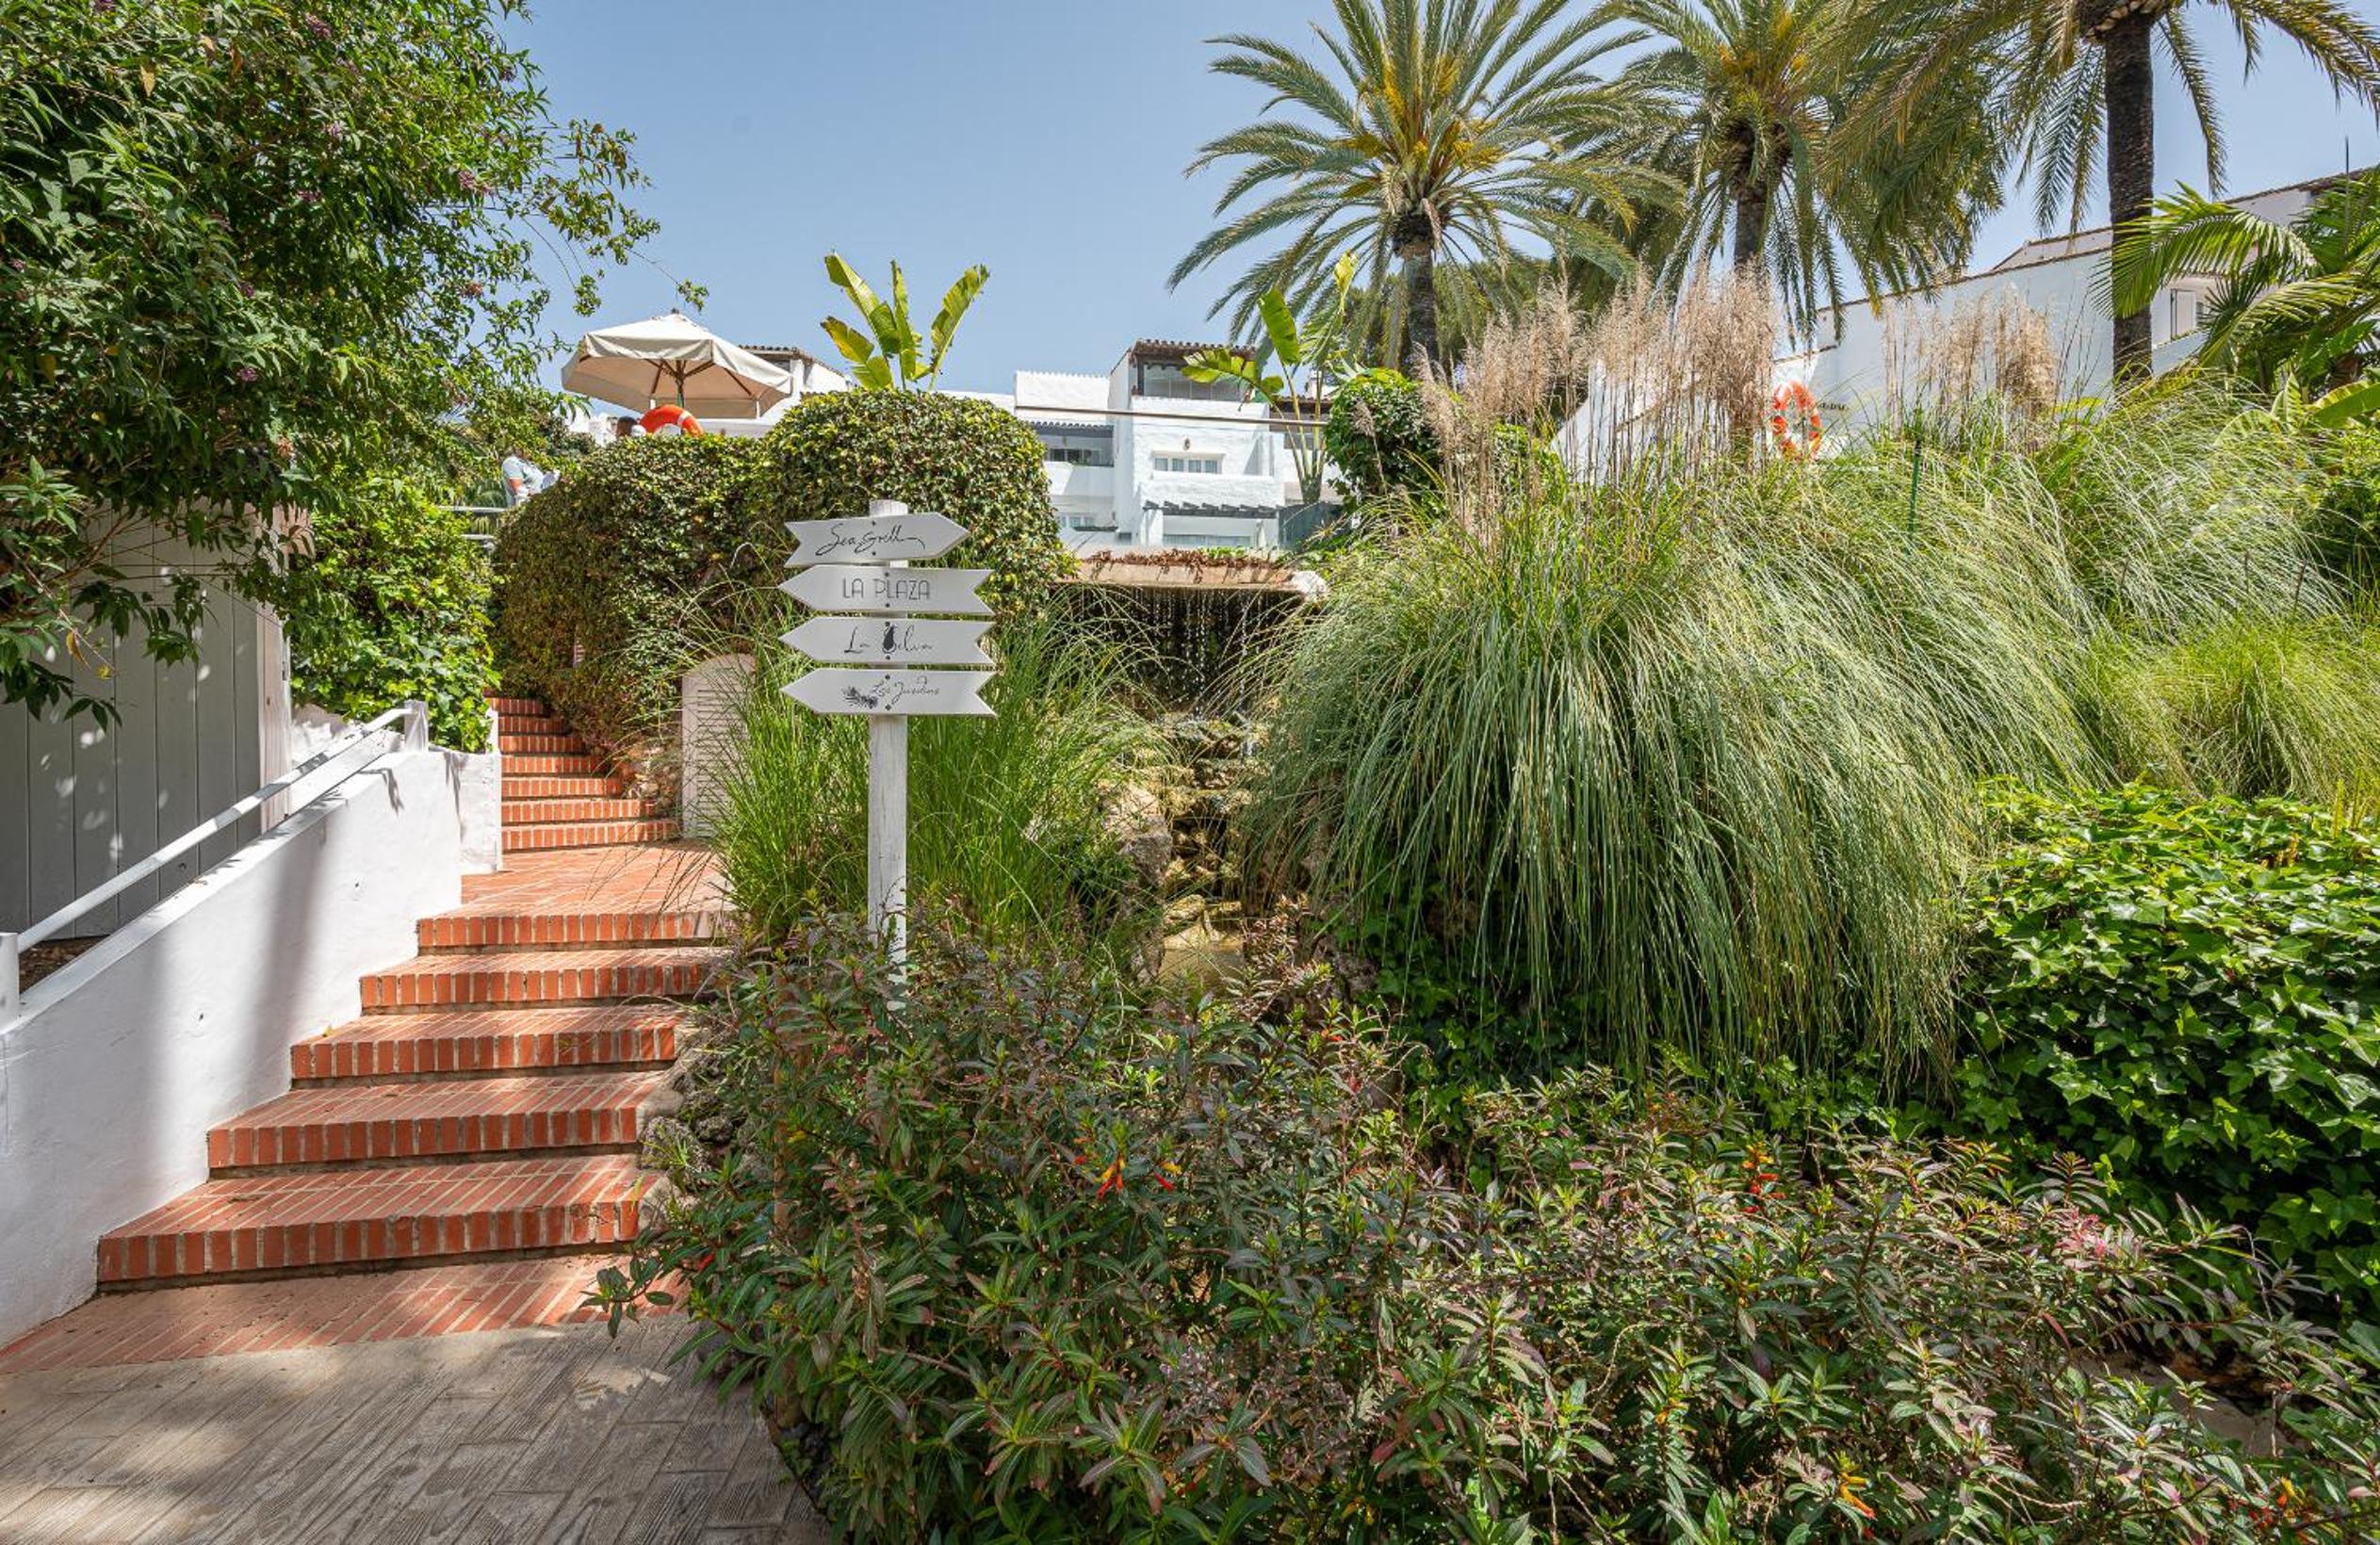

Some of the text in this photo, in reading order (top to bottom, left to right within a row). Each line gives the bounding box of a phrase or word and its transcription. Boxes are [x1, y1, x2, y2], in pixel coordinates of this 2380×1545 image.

[815, 523, 856, 556] Sea
[843, 577, 931, 600] LA PLAZA
[843, 626, 870, 654] La
